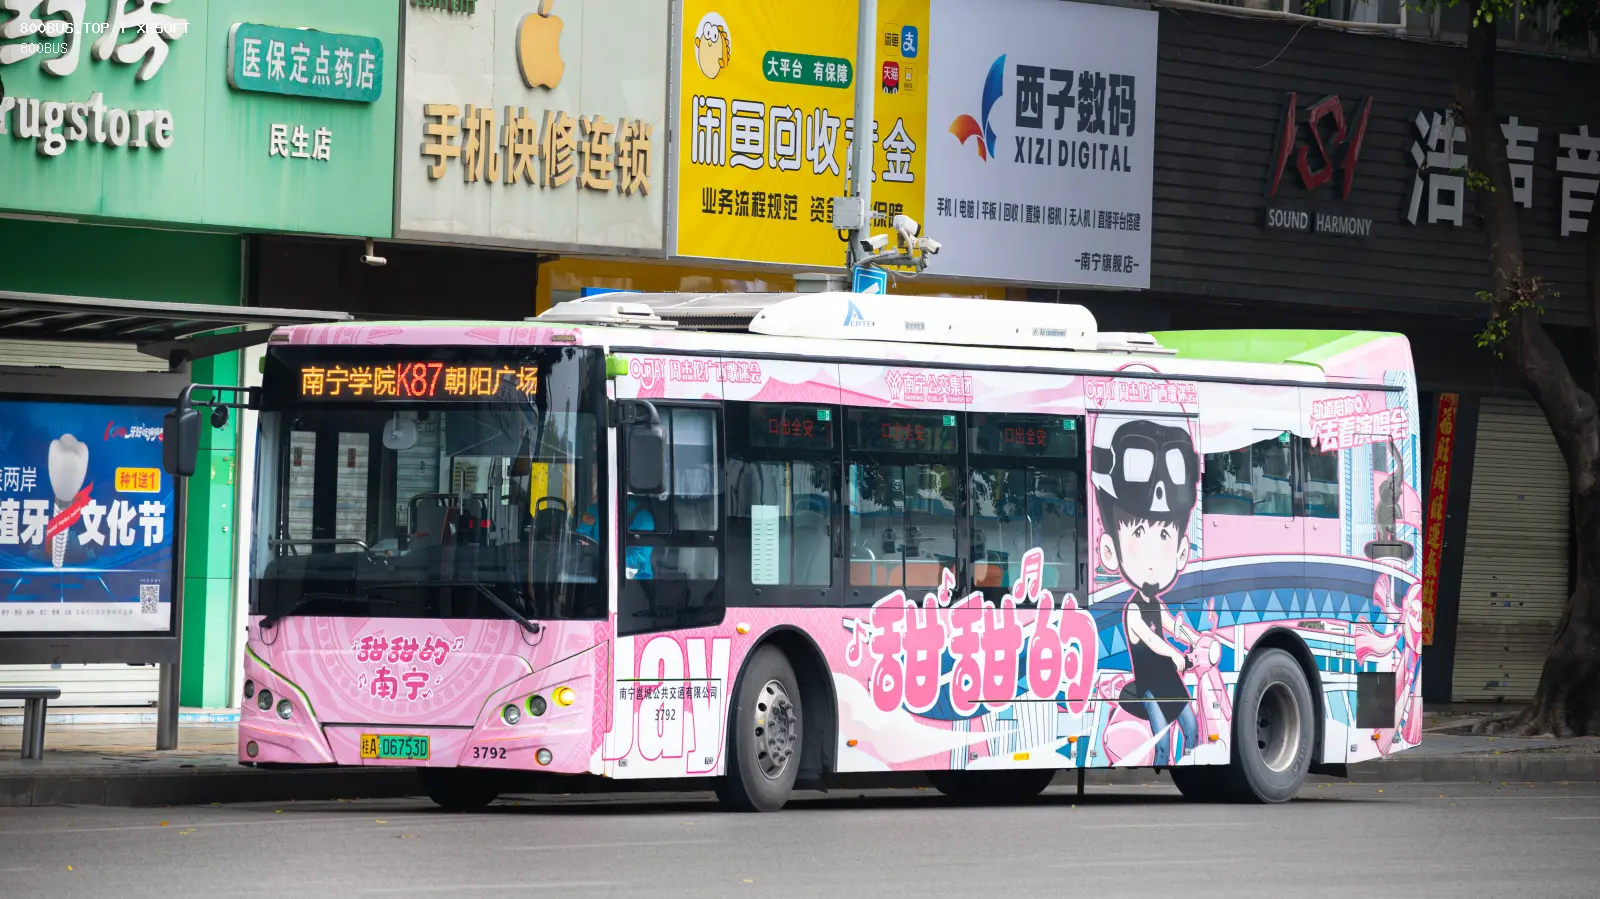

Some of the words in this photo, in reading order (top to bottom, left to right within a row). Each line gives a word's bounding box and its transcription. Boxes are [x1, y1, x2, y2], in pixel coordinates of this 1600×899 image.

[243, 38, 376, 90] 医保定点药店
[767, 56, 803, 78] 大平台
[813, 62, 848, 84] 有保障
[884, 66, 899, 81] 天猫
[1015, 64, 1136, 137] 西子数码
[0, 92, 174, 155] rugstore
[269, 123, 332, 162] 民生店
[421, 104, 652, 196] 手机快修连锁
[1014, 135, 1052, 166] XIZI
[1058, 140, 1132, 173] DIGITAL
[701, 187, 798, 221] 业务流程规范
[937, 198, 952, 217] 手机
[959, 200, 974, 219] 电脑
[981, 202, 997, 221] 平板
[1003, 203, 1019, 222] 回收
[1025, 205, 1041, 224] 置换
[1047, 207, 1062, 226] 相机
[1069, 208, 1091, 228] 无人机
[1097, 210, 1141, 232] 直播平台搭建
[1268, 208, 1309, 229] SOUND
[1316, 213, 1372, 236] HARMONY
[302, 365, 395, 396] 南宁学院
[397, 363, 443, 396] K87
[445, 366, 538, 396] 朝阳广场
[903, 373, 973, 397] 南宁公交集团
[1319, 406, 1409, 453] 去看演唱会
[0, 466, 37, 492] 两岸
[120, 472, 156, 489] 种1送1
[0, 498, 49, 545] 植牙
[78, 499, 166, 547] 文化节
[355, 635, 450, 666] 甜甜的
[870, 589, 1098, 718] 甜甜的
[370, 667, 431, 701] 南宁
[619, 686, 718, 700] 南宁邕城公共交通有限公司
[602, 634, 732, 774] Jay
[654, 708, 676, 721] 3792
[472, 746, 507, 760] 3792
